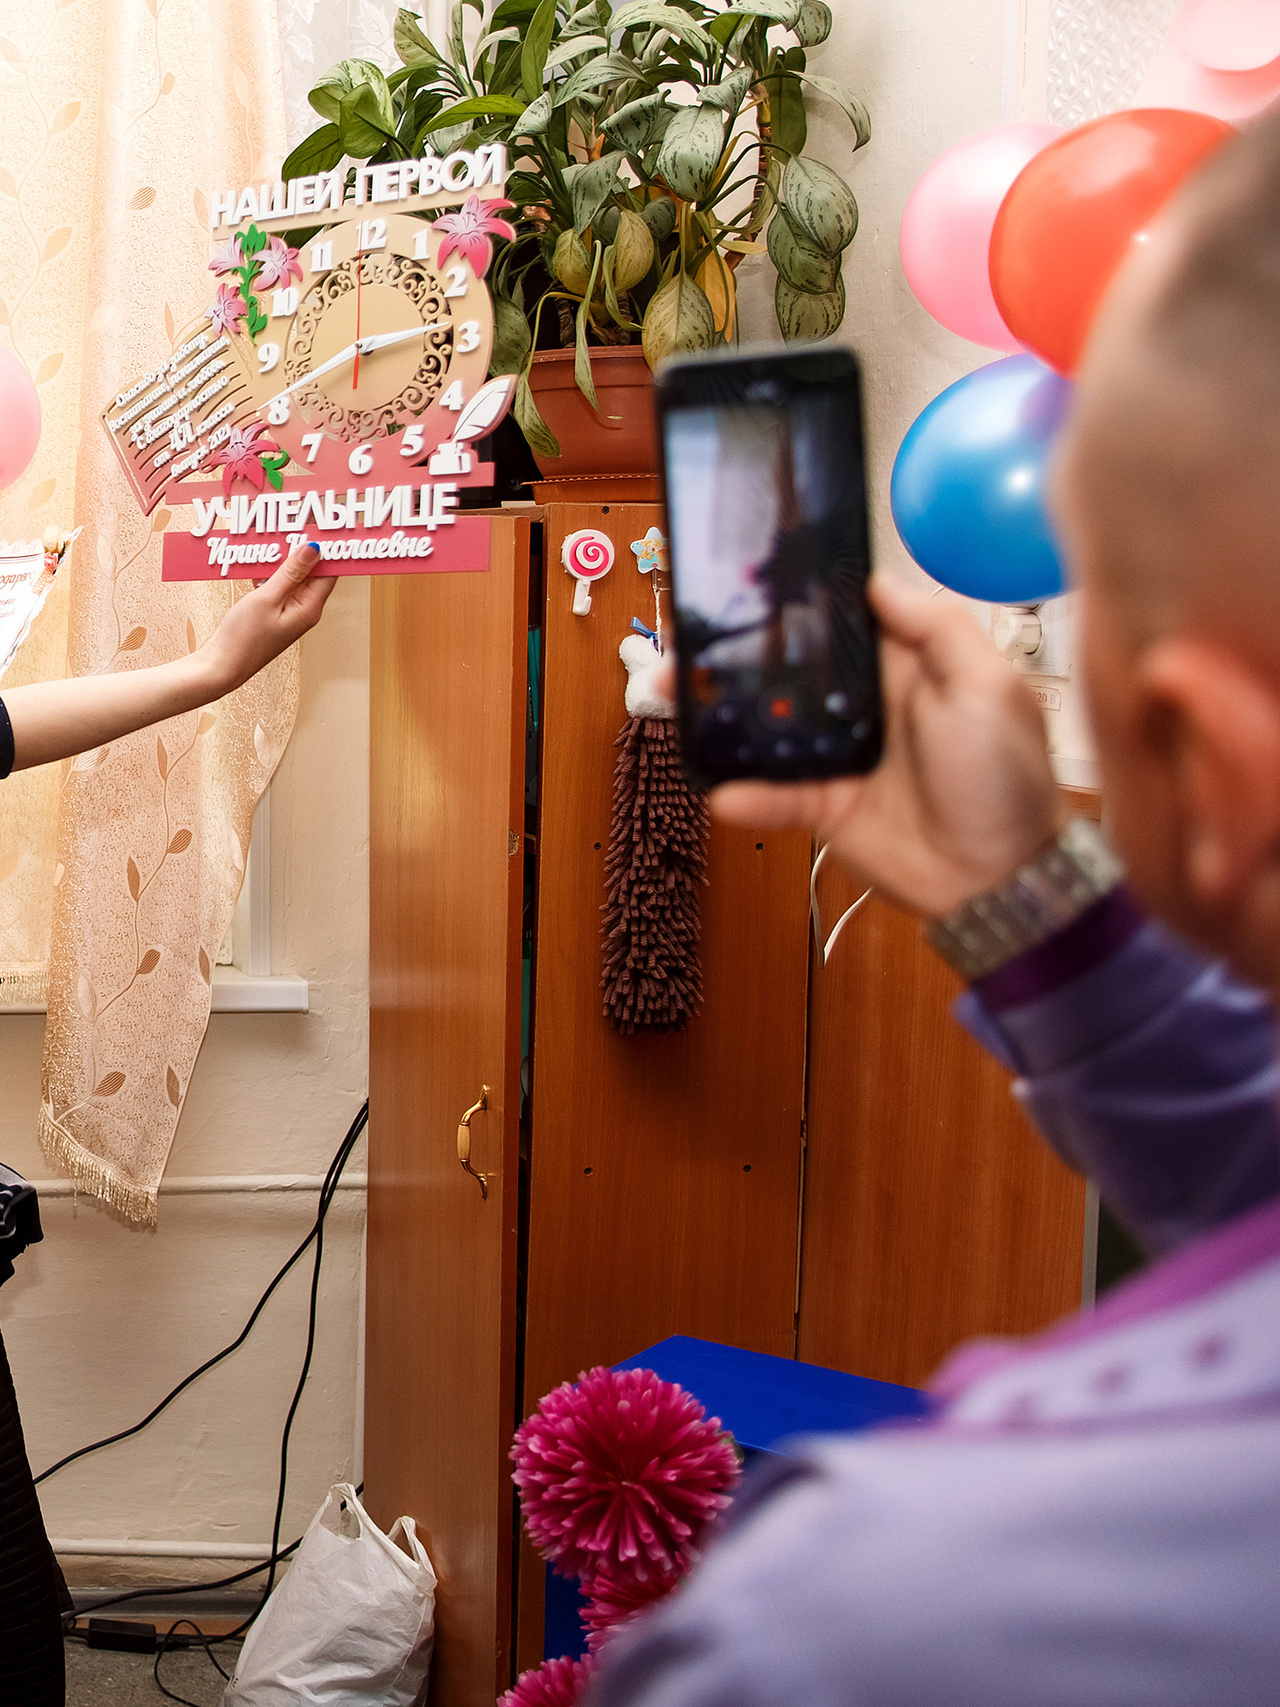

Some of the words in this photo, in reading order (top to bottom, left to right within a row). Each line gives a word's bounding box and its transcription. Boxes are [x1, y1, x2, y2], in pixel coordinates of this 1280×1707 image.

[212, 171, 344, 228] НАШЕЙ
[354, 143, 507, 206] ПЕРВОЙ
[356, 219, 388, 251] 12
[412, 229, 430, 261] 1
[309, 240, 334, 273] 11
[444, 266, 468, 298] 2
[270, 286, 299, 318] 10
[456, 321, 481, 353] 3
[170, 336, 231, 387] понимание,
[258, 343, 281, 373] 9
[116, 373, 156, 407] Спасибо
[156, 361, 170, 382] за
[177, 387, 188, 400] и
[438, 380, 464, 411] 4
[267, 396, 290, 426] 8
[153, 450, 173, 468] от
[196, 402, 236, 437] класса
[207, 423, 232, 450] 2021
[300, 433, 324, 463] 7
[399, 424, 426, 457] 5
[348, 444, 374, 476] 6
[190, 482, 458, 537] УЧИТЕЛЬНИЦЕ
[206, 537, 282, 577] Ирине
[286, 530, 434, 562] Нколаевне
